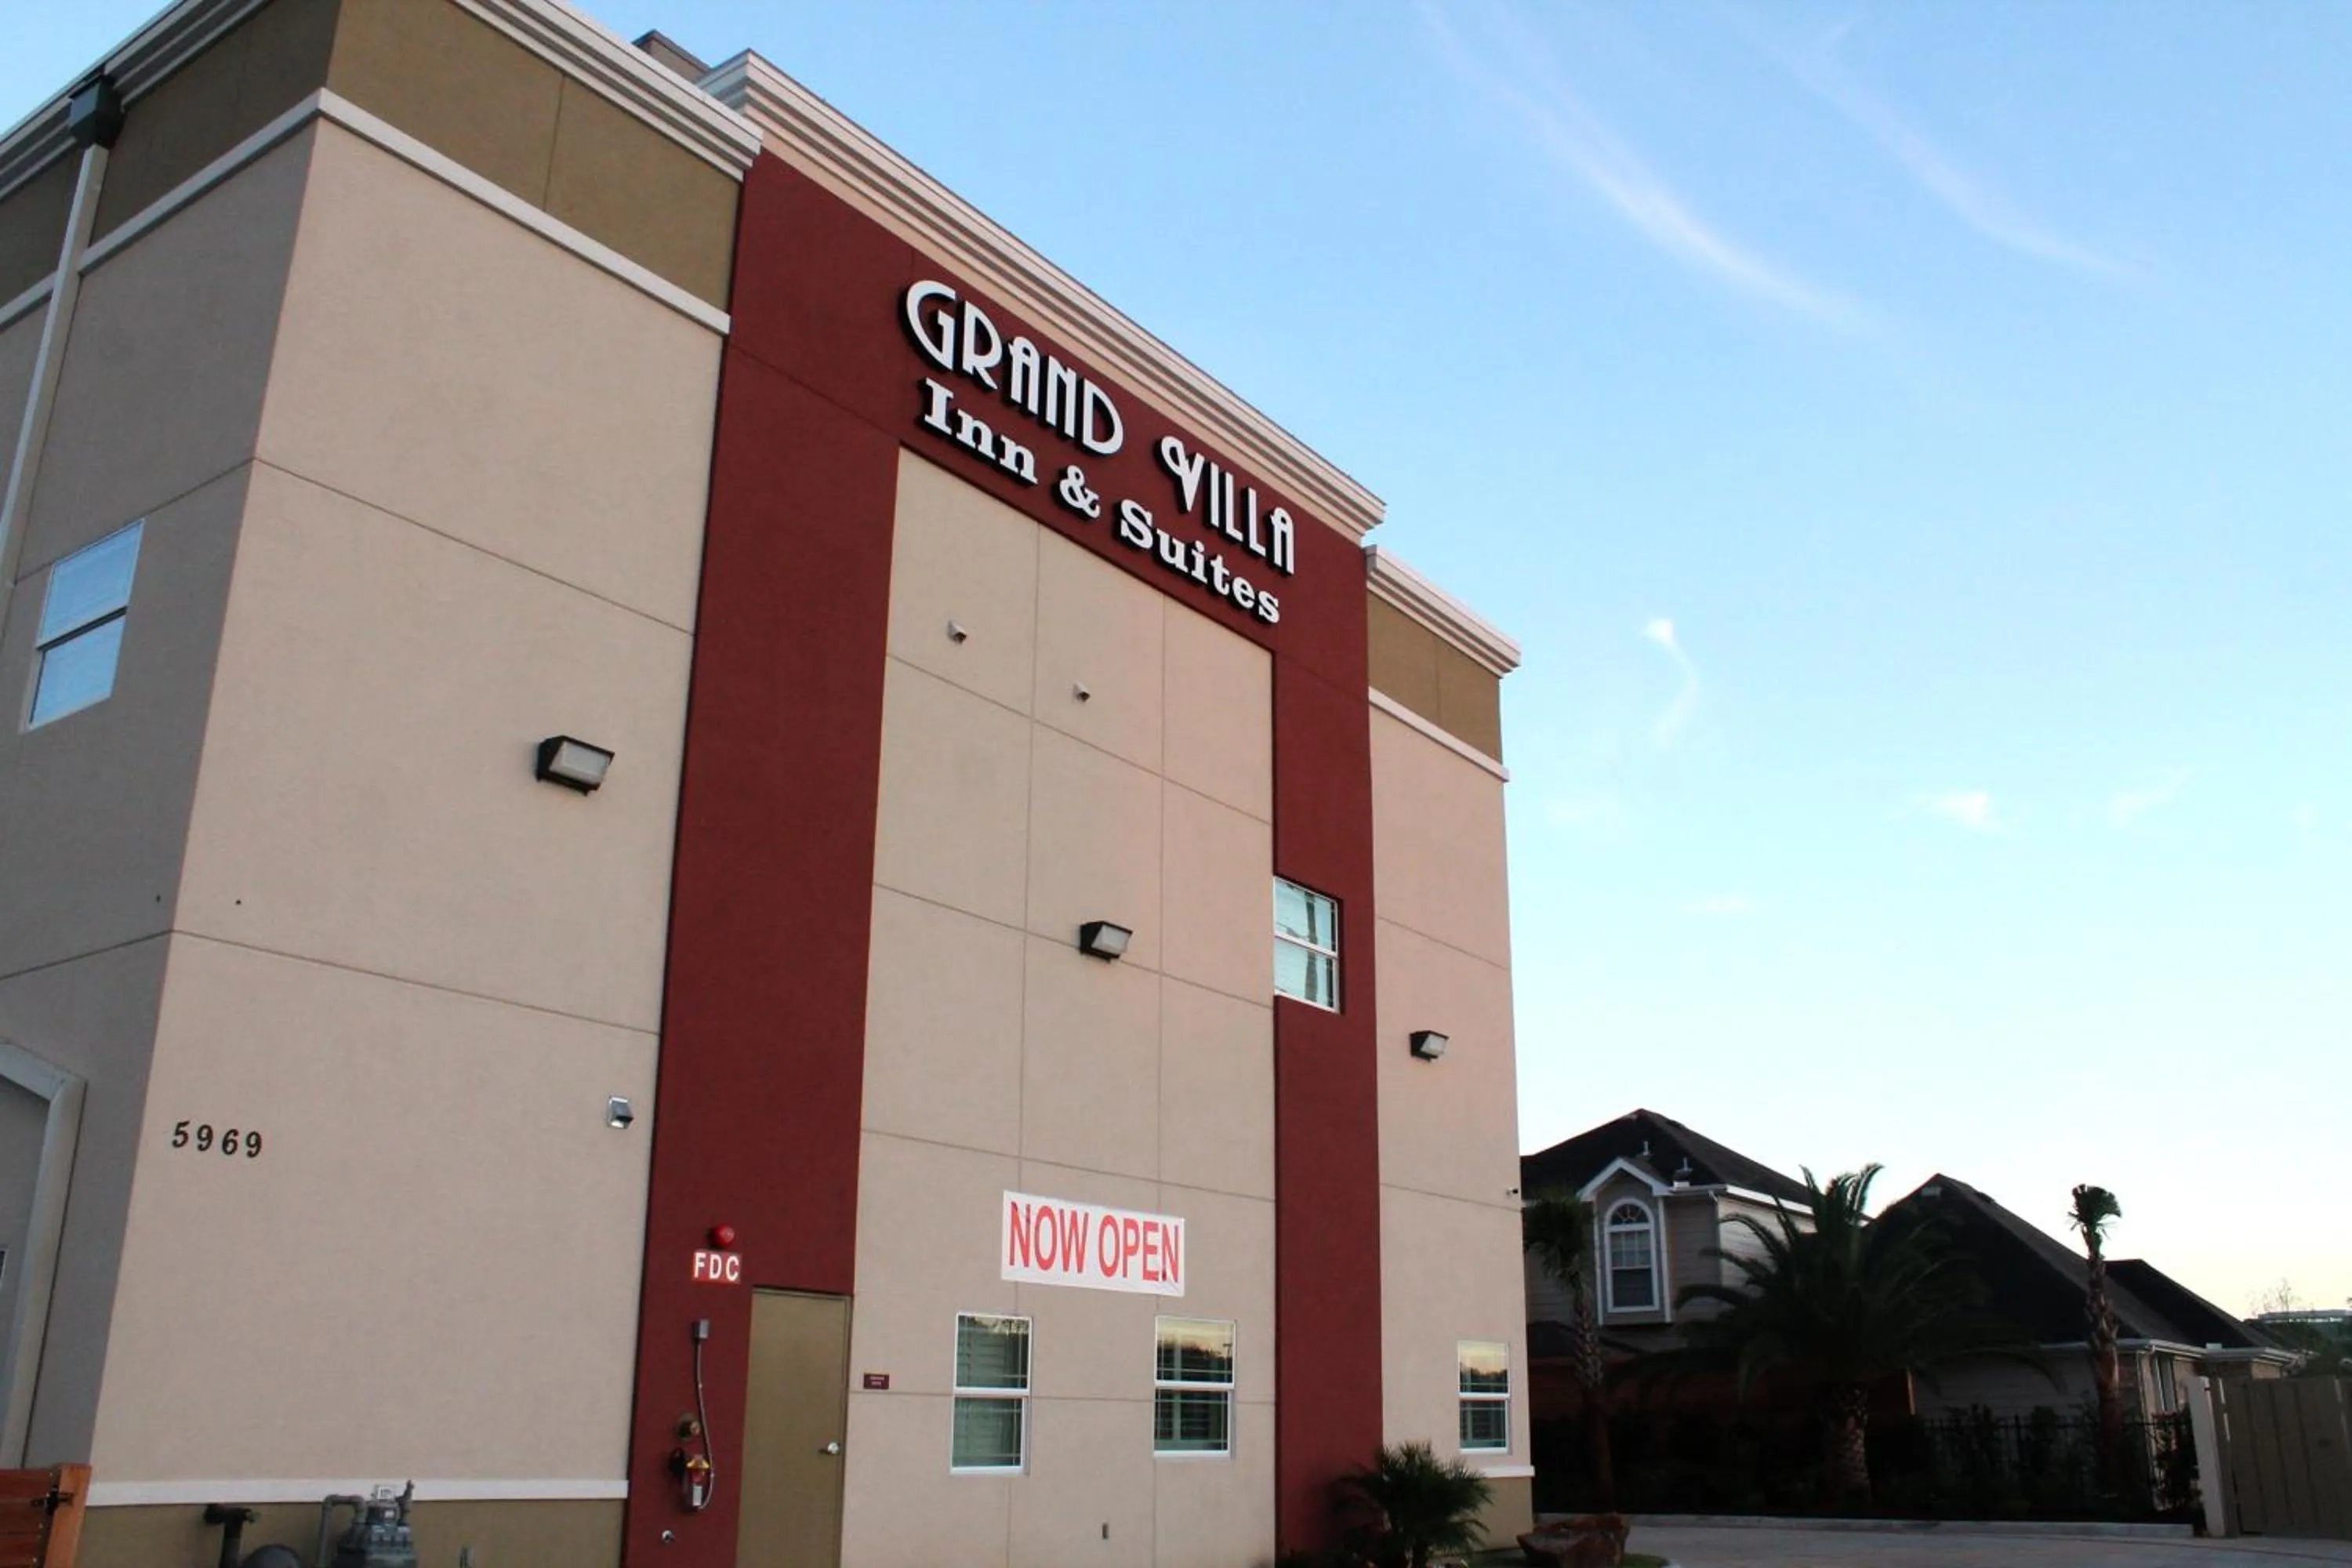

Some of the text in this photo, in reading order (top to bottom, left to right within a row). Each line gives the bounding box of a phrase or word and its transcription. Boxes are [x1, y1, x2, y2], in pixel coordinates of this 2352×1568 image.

[906, 280, 1294, 575] GRAND VILLA
[924, 377, 1280, 623] Inn & Suites
[172, 1120, 263, 1159] 5969
[693, 1252, 740, 1282] FDC
[1008, 1201, 1179, 1283] NOW OPEN
